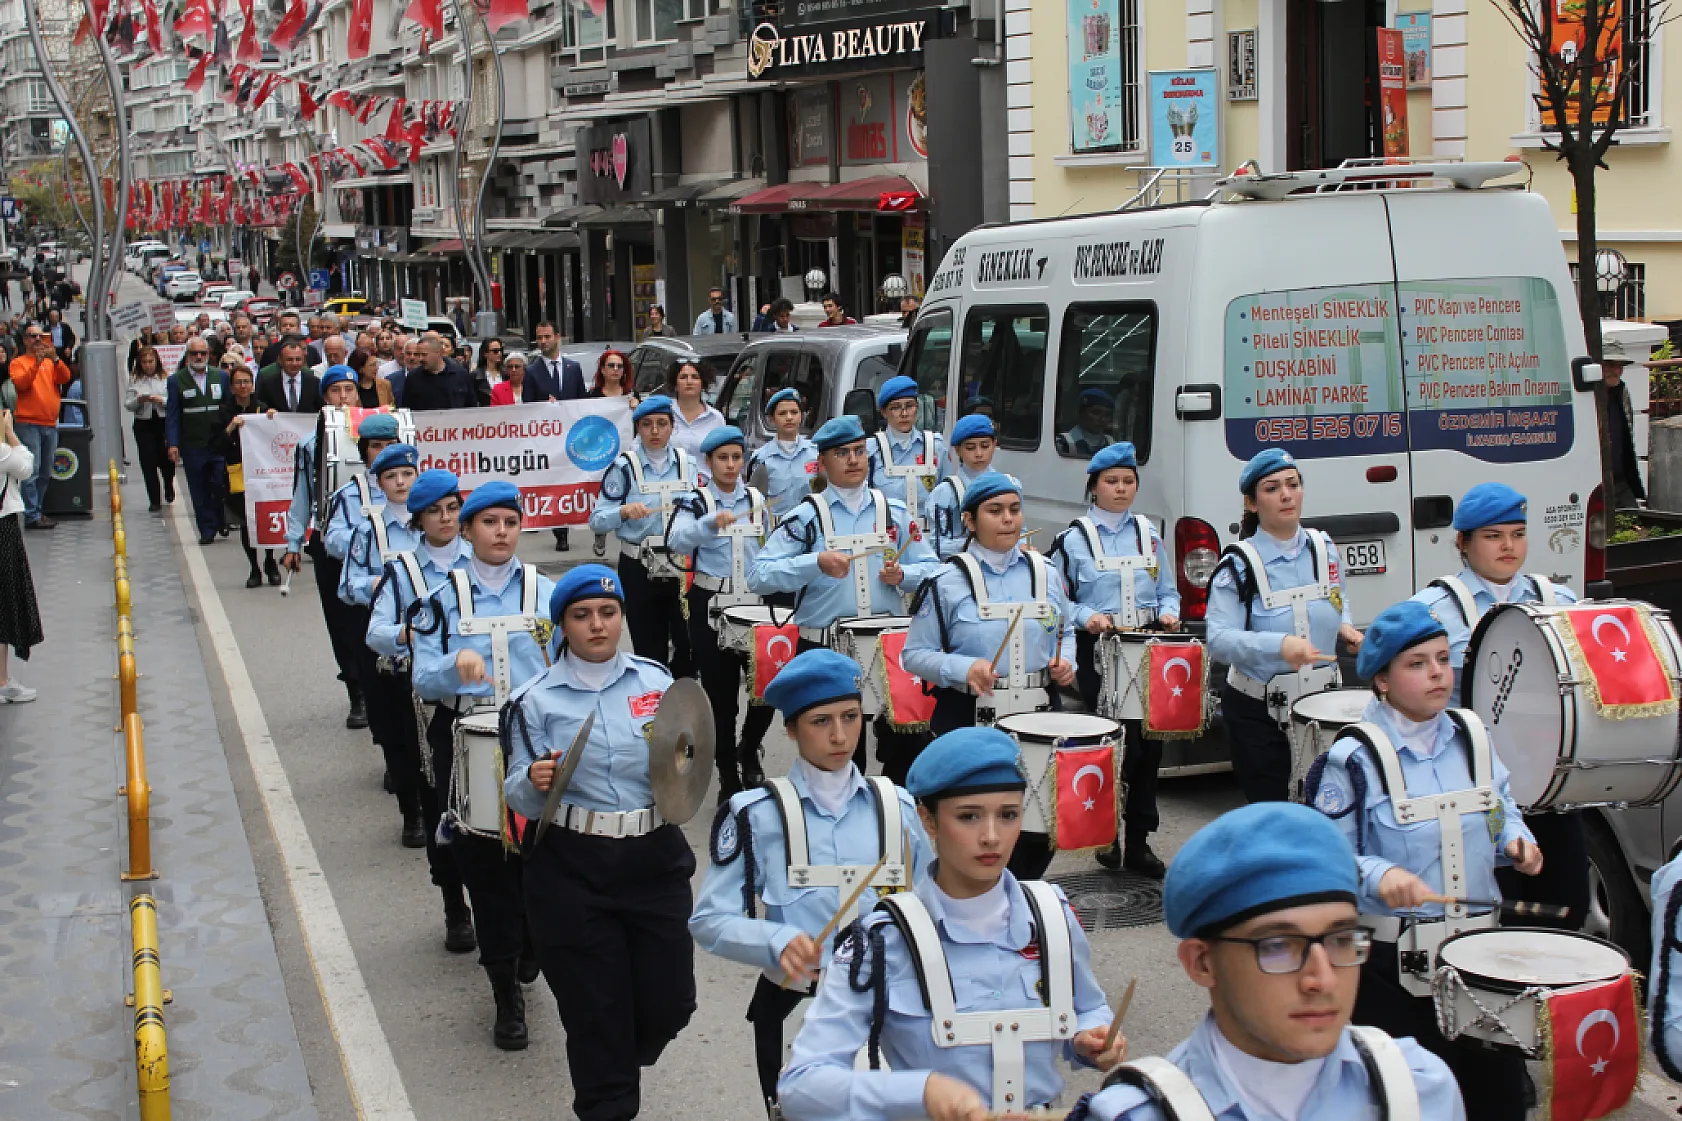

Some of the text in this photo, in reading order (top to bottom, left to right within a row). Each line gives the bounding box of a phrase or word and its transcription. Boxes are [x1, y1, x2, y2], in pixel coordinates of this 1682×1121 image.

[831, 20, 926, 61] BEAUTY
[1174, 141, 1192, 153] 25
[1252, 297, 1389, 324] Menteşeli SİNEKLİK
[1415, 297, 1521, 319] PVC Kapı ve Pencere
[1253, 325, 1361, 350] Pileli SİNEKLİK
[1416, 324, 1525, 343] PVC Pencere Contası
[1254, 354, 1337, 383] DUŞKABİNİ
[1418, 354, 1439, 371] PVC
[1441, 353, 1485, 371] Pencere
[1256, 384, 1369, 407] LAMİNAT PARKE
[1420, 378, 1560, 400] PVC Pencere Bakım Onarım
[414, 419, 563, 443] AĞLIK MÜDÜRLÜĞÜ
[1255, 413, 1401, 442] 0532 526 07 16
[1438, 409, 1559, 430] ÖZDEMİR İNŞAAT
[1346, 544, 1379, 567] 658
